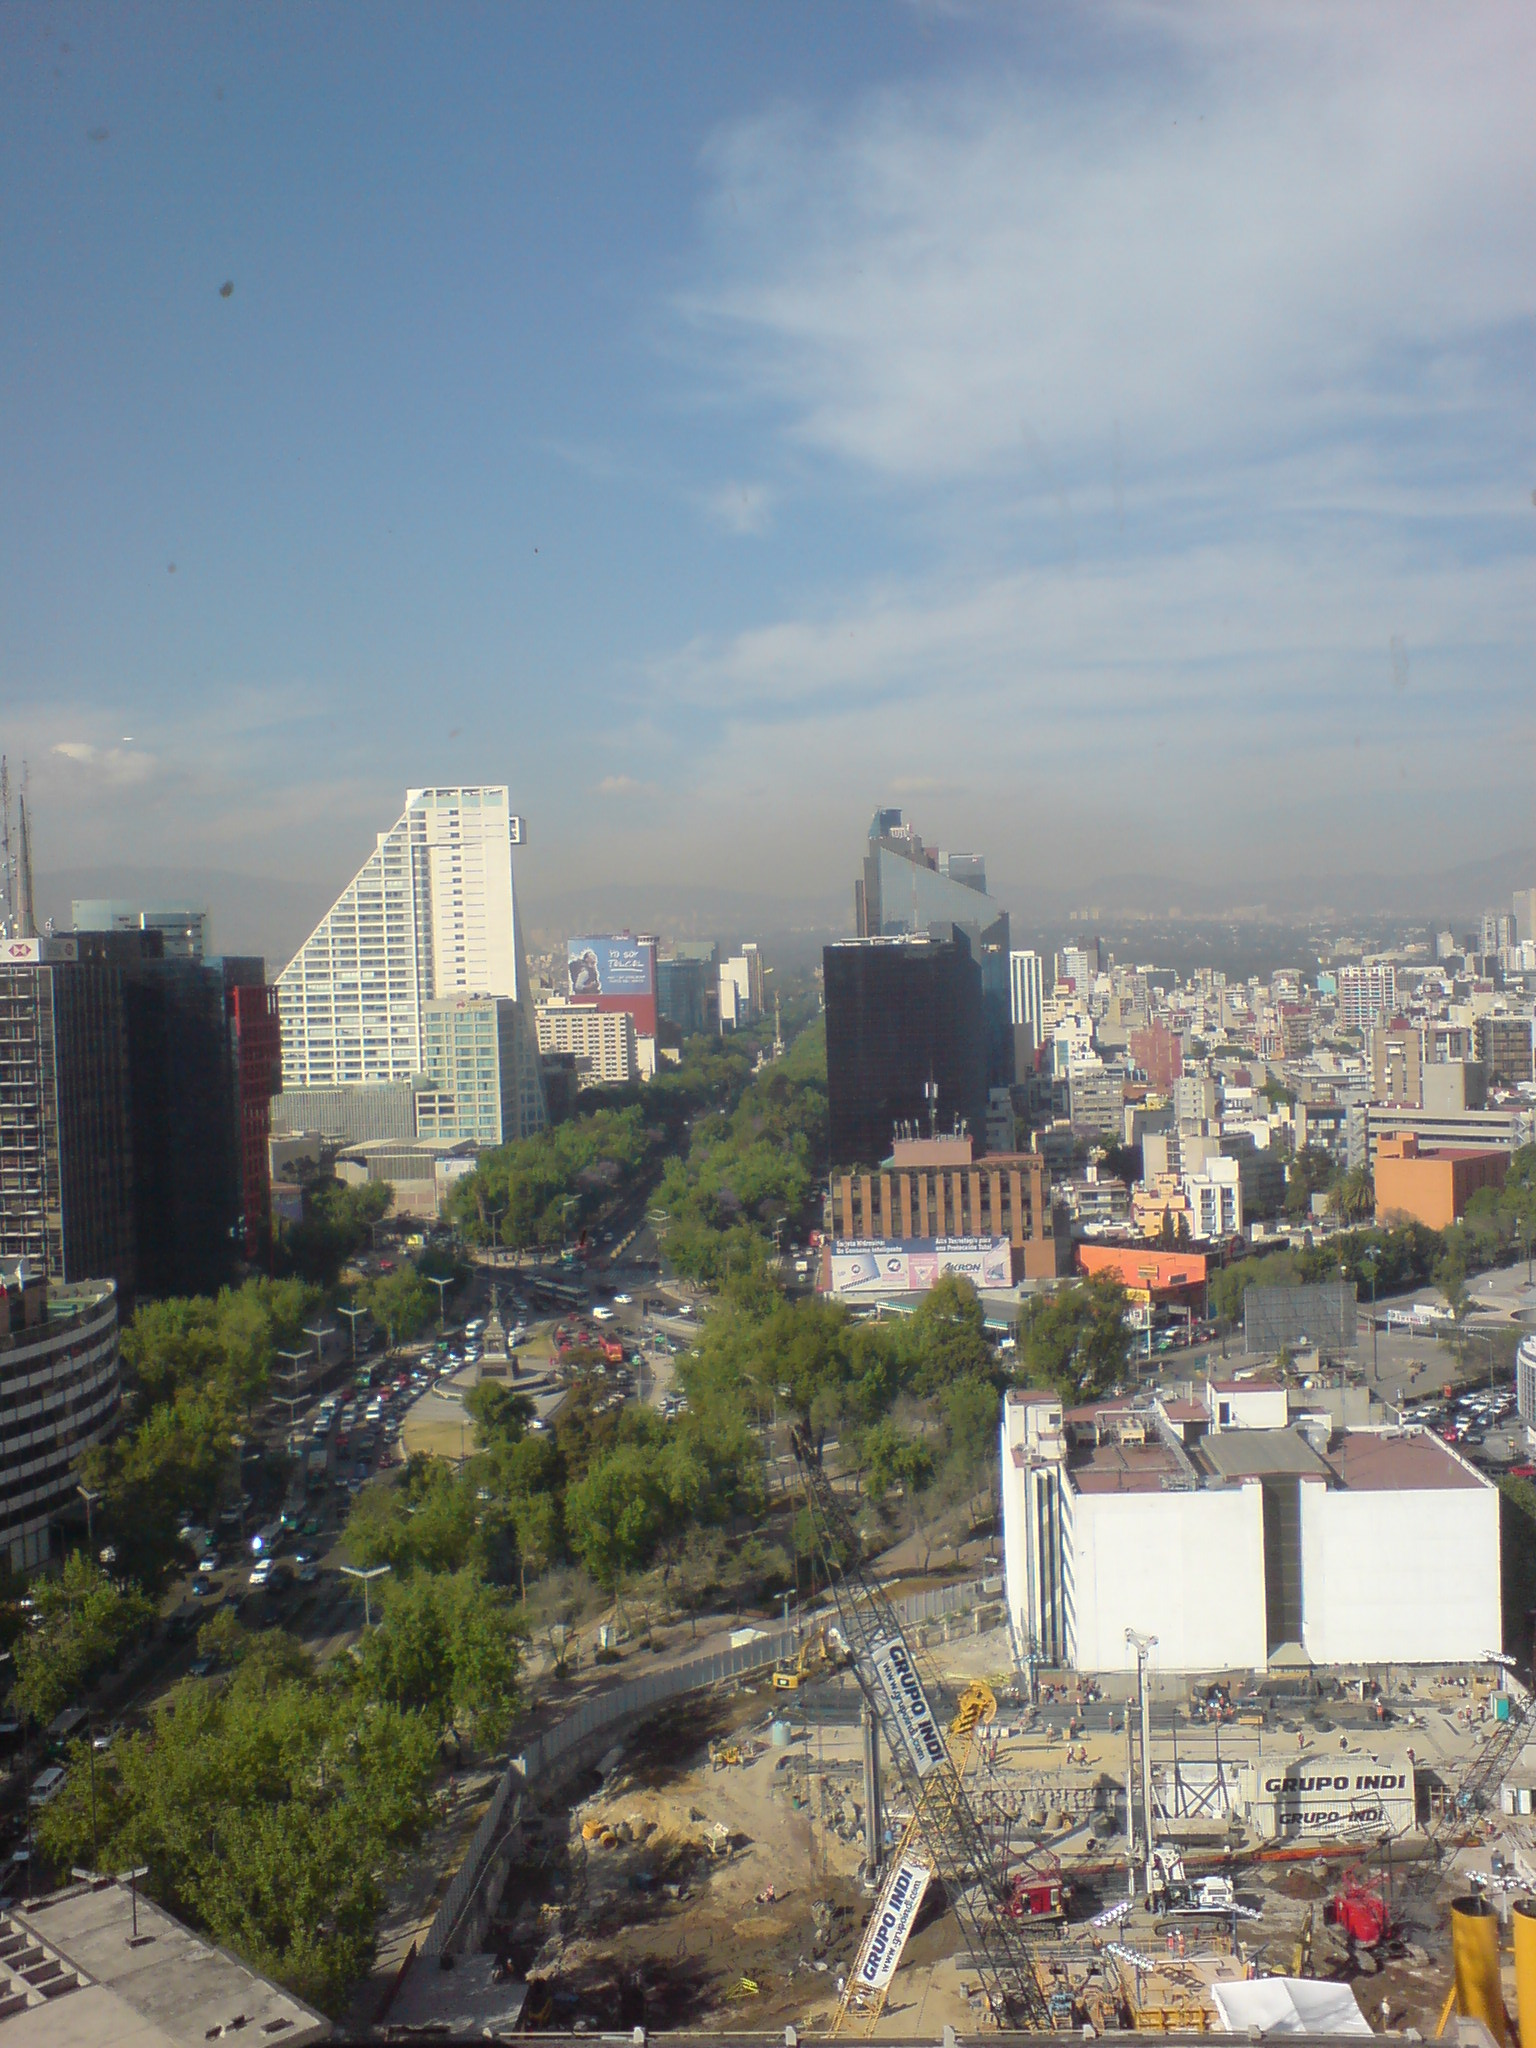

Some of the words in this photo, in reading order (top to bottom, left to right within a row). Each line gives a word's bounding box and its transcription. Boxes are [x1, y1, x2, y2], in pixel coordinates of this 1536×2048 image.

[944, 1262, 981, 1272] AKRON
[889, 1645, 926, 1717] GRUPO
[918, 1719, 946, 1763] INDI
[1264, 1775, 1350, 1793] GRUPO
[1355, 1774, 1406, 1790] INDI
[1279, 1811, 1340, 1825] GRUPO
[1348, 1809, 1384, 1822] INDI
[863, 1911, 896, 1982] GRUPO
[888, 1867, 914, 1913] INDI
